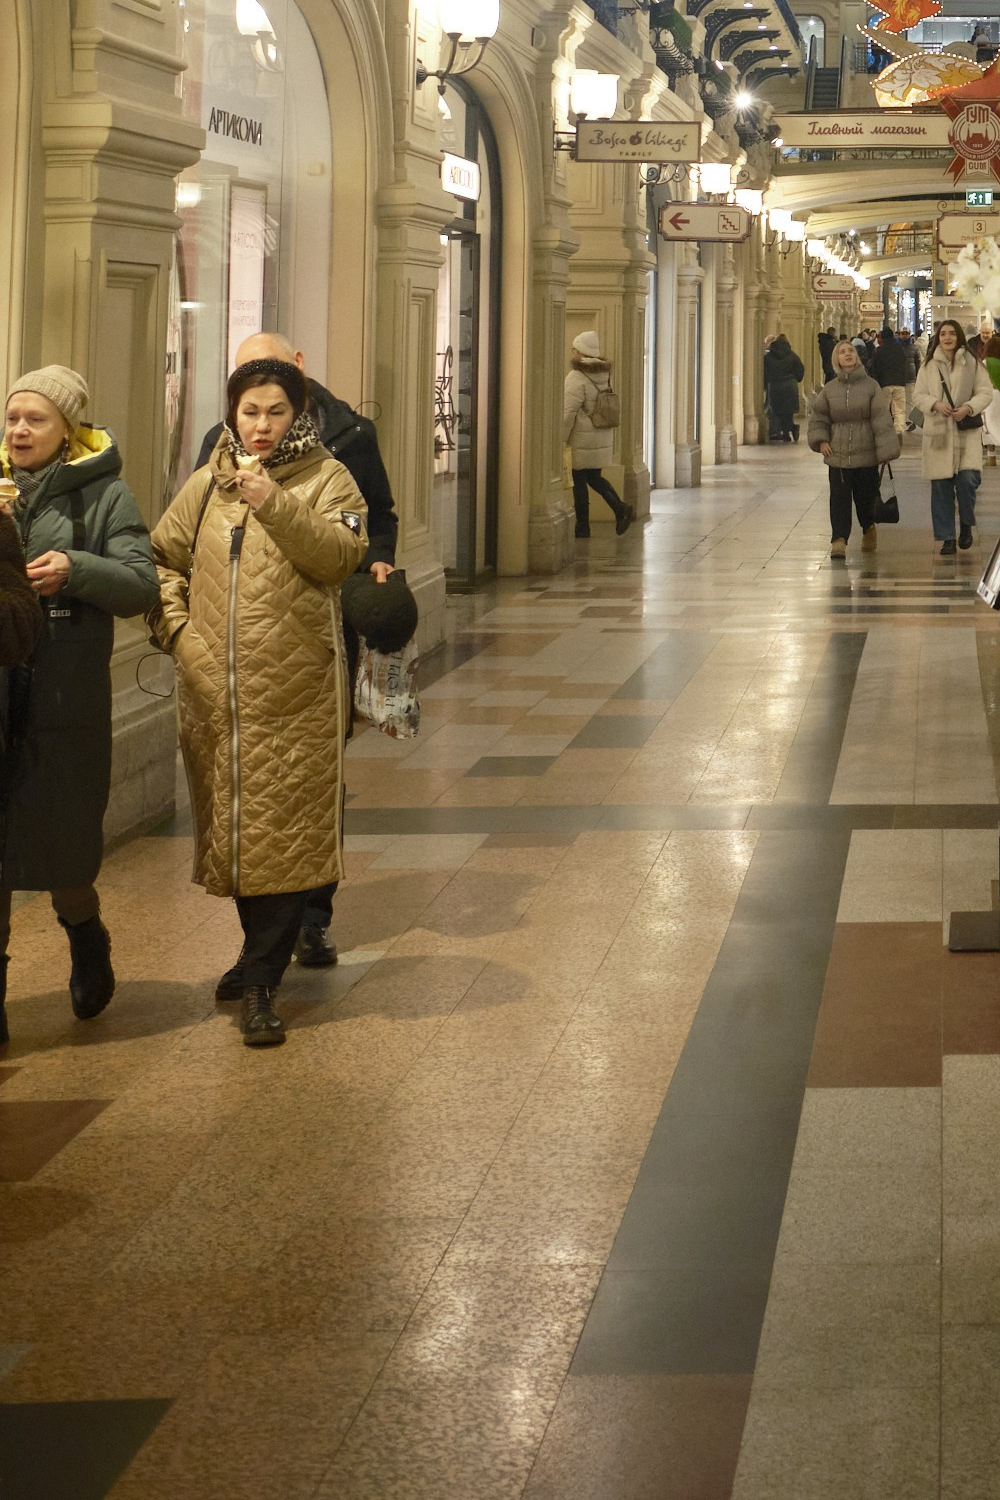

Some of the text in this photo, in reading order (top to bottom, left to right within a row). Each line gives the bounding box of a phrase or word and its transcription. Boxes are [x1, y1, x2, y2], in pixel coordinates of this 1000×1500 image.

[966, 106, 990, 124] ГУМ
[208, 106, 263, 147] АРТИКОЛИ
[807, 120, 928, 136] Главный магазин
[588, 129, 628, 149] Bosco
[968, 161, 987, 170] GUM
[976, 222, 983, 232] 3
